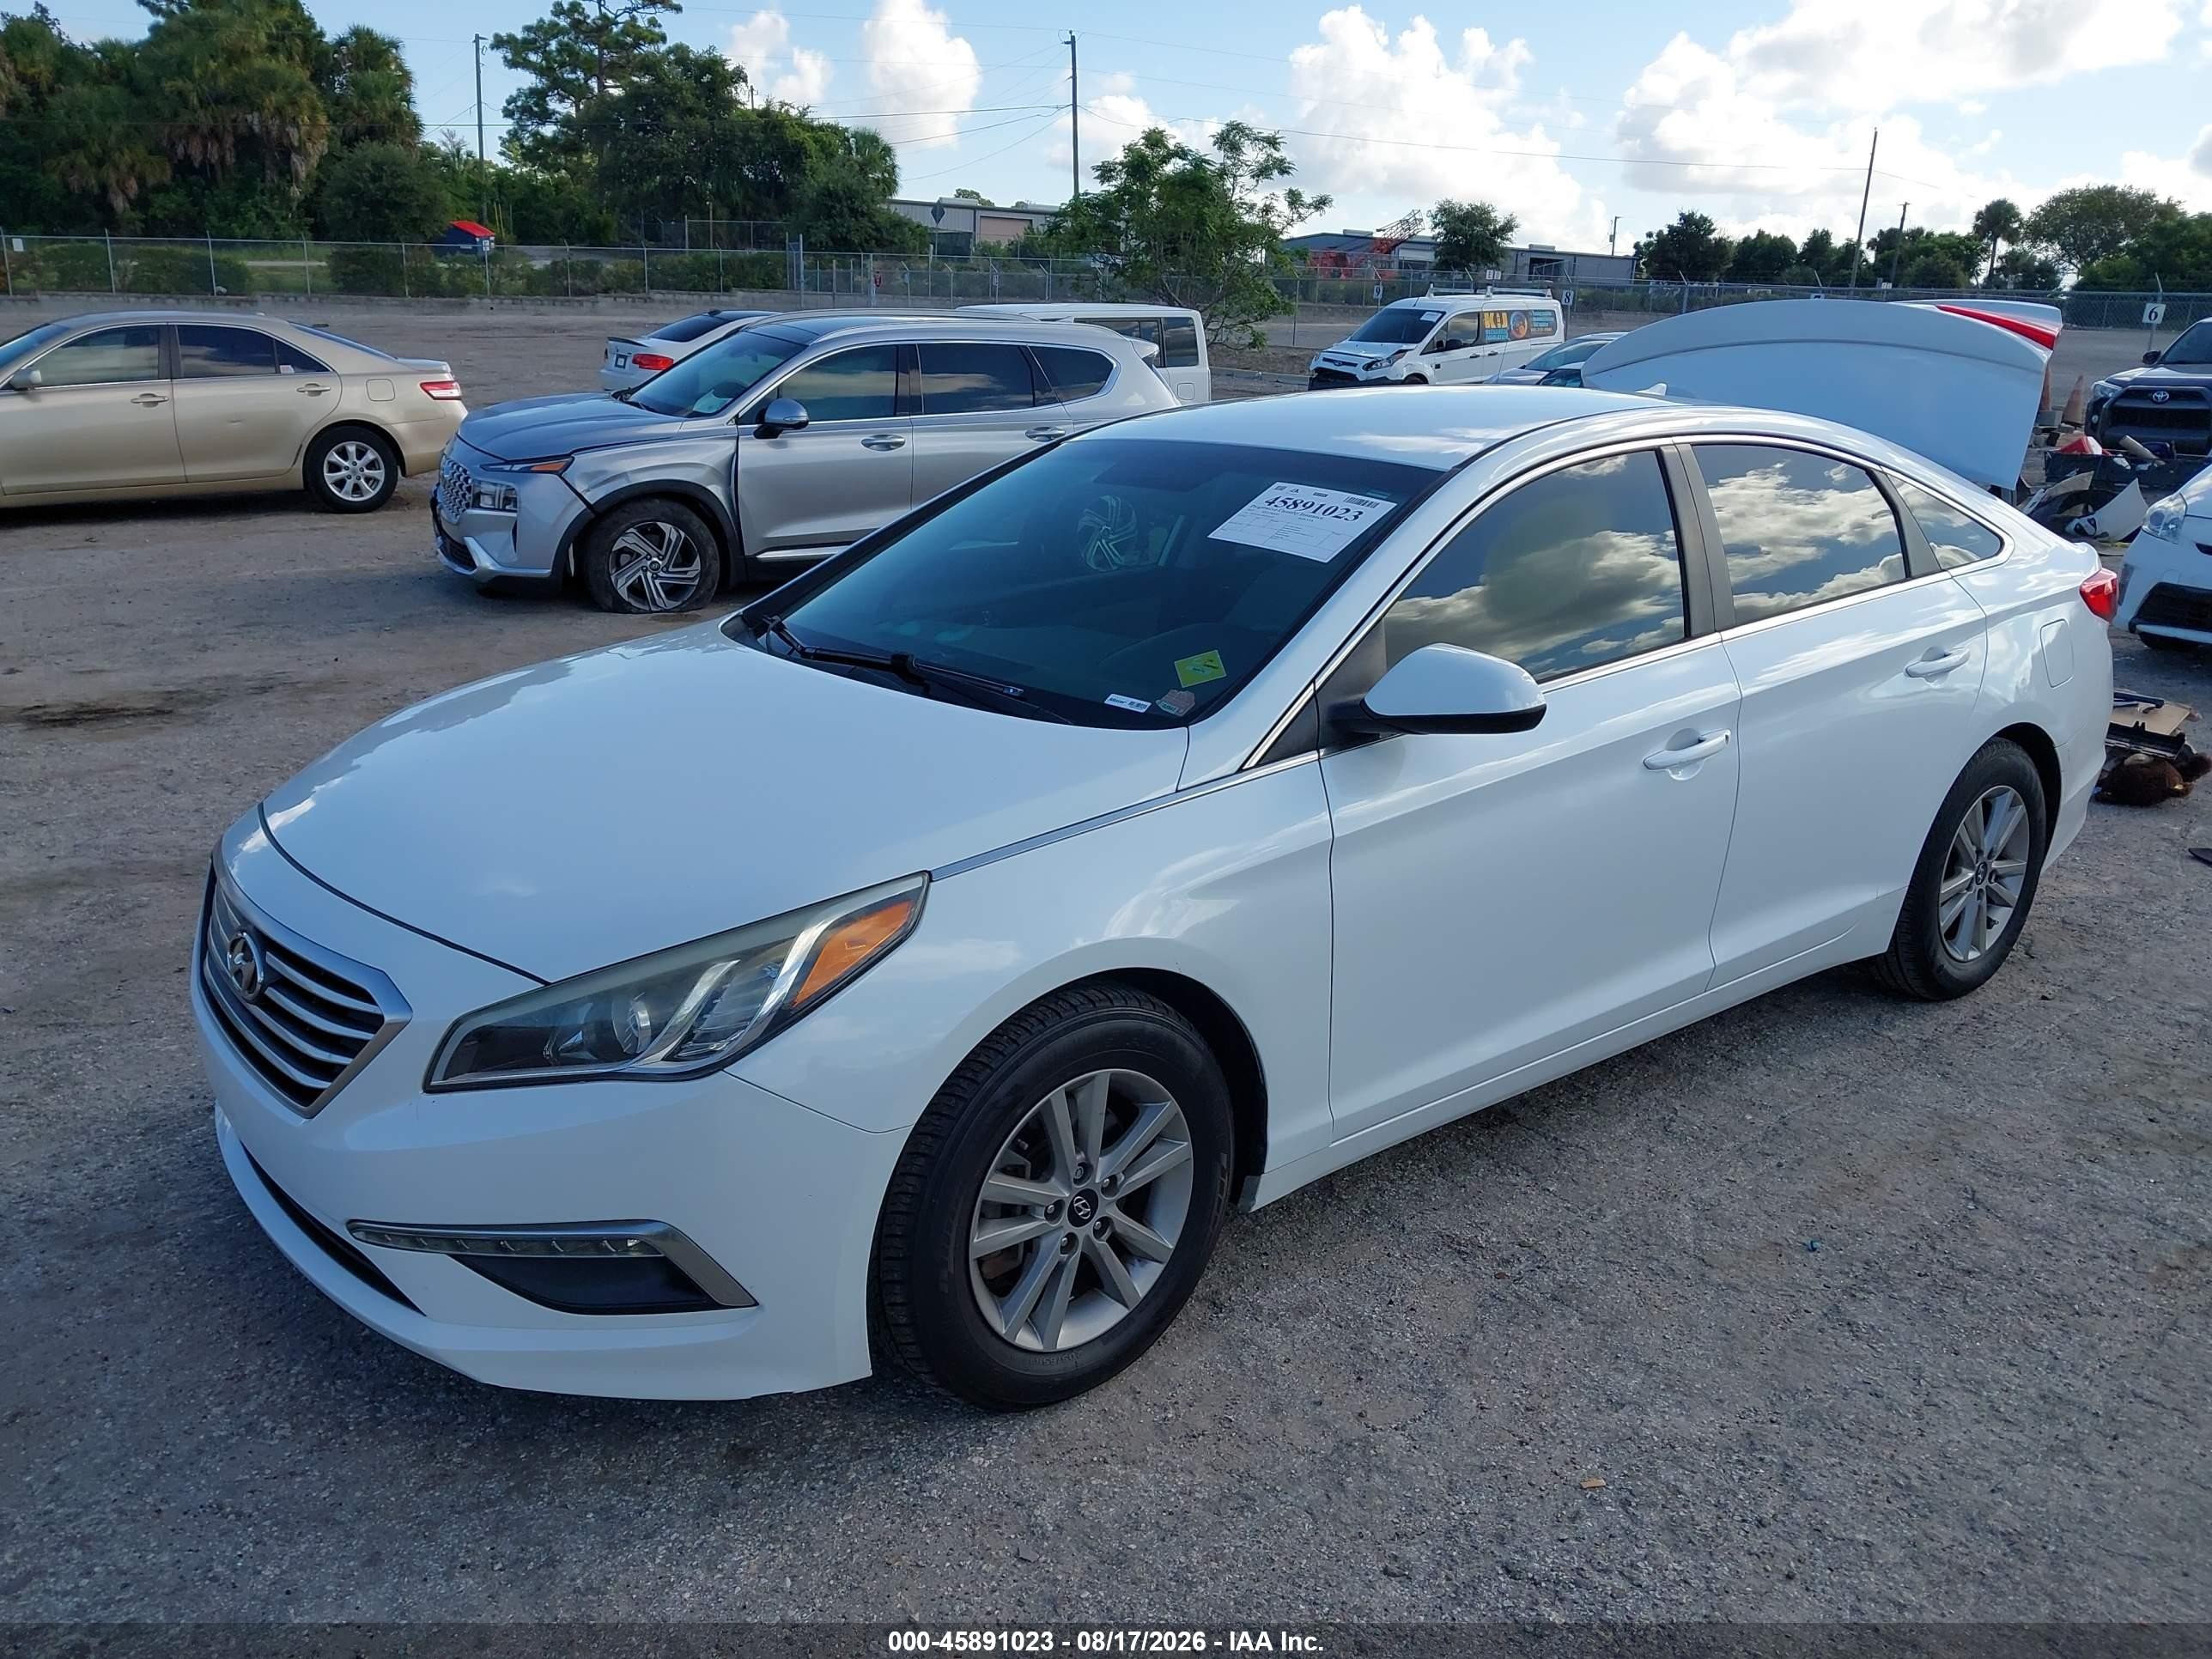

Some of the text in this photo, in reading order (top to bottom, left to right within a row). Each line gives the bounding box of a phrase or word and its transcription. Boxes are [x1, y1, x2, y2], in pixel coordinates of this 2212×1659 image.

[1376, 287, 1381, 296] 9
[1565, 292, 1571, 303] 8
[2148, 305, 2160, 321] 6
[1265, 495, 1363, 522] 45891023
